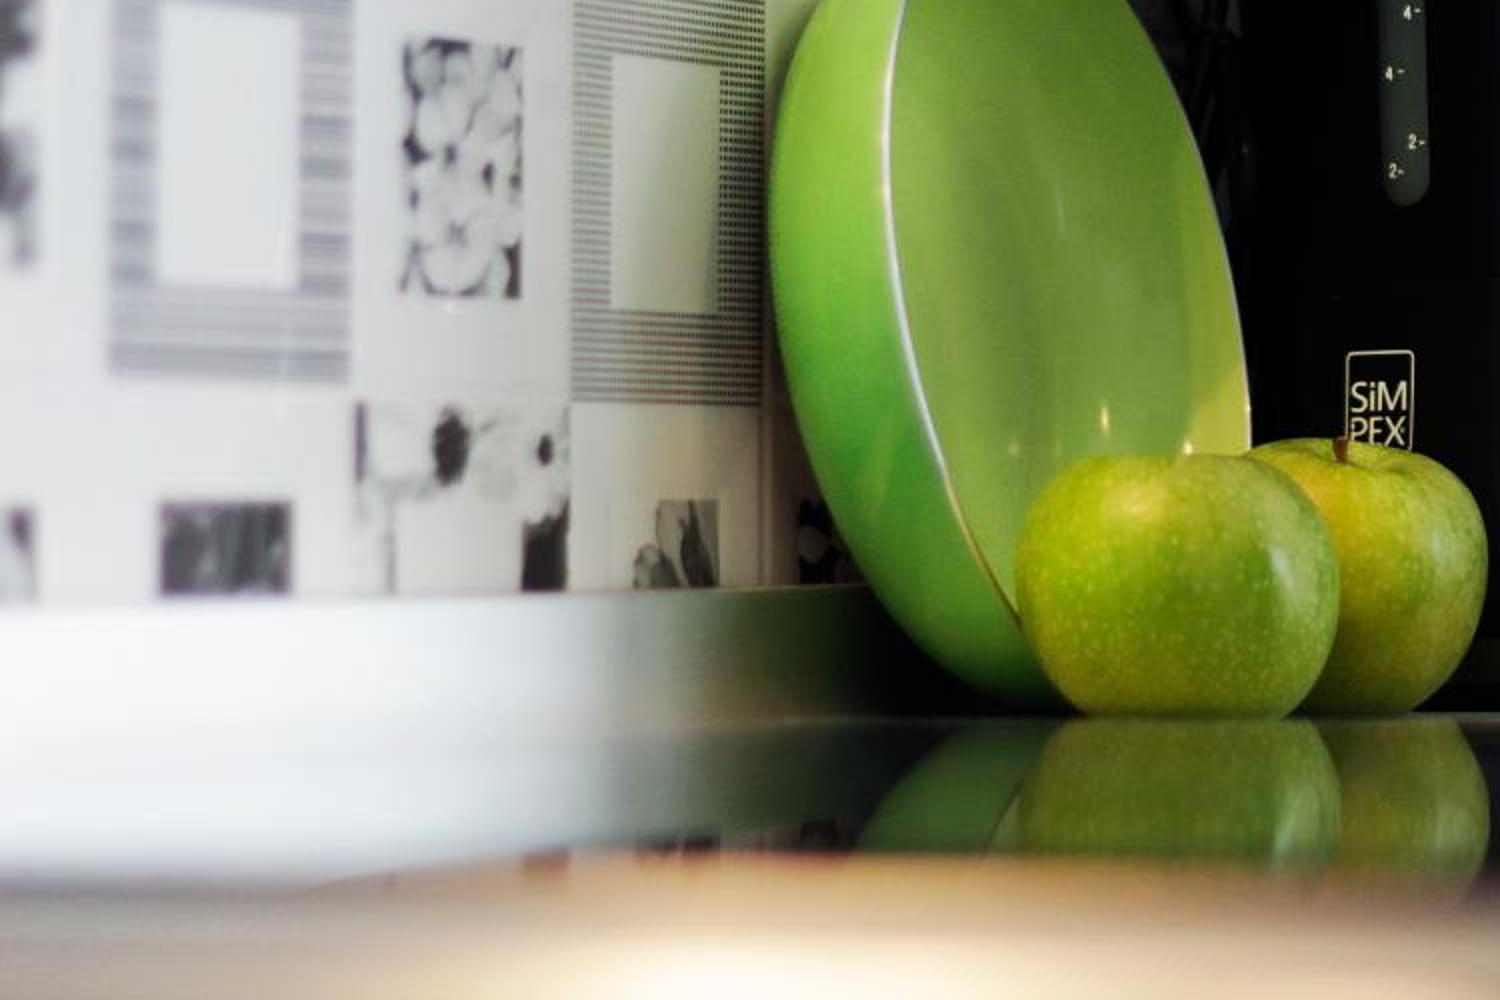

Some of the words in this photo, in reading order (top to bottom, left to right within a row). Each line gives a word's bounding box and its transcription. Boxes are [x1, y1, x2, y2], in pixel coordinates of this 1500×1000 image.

[1403, 5, 1413, 21] 4
[1385, 66, 1394, 82] 4
[1408, 133, 1417, 150] 2
[1388, 163, 1398, 180] 2
